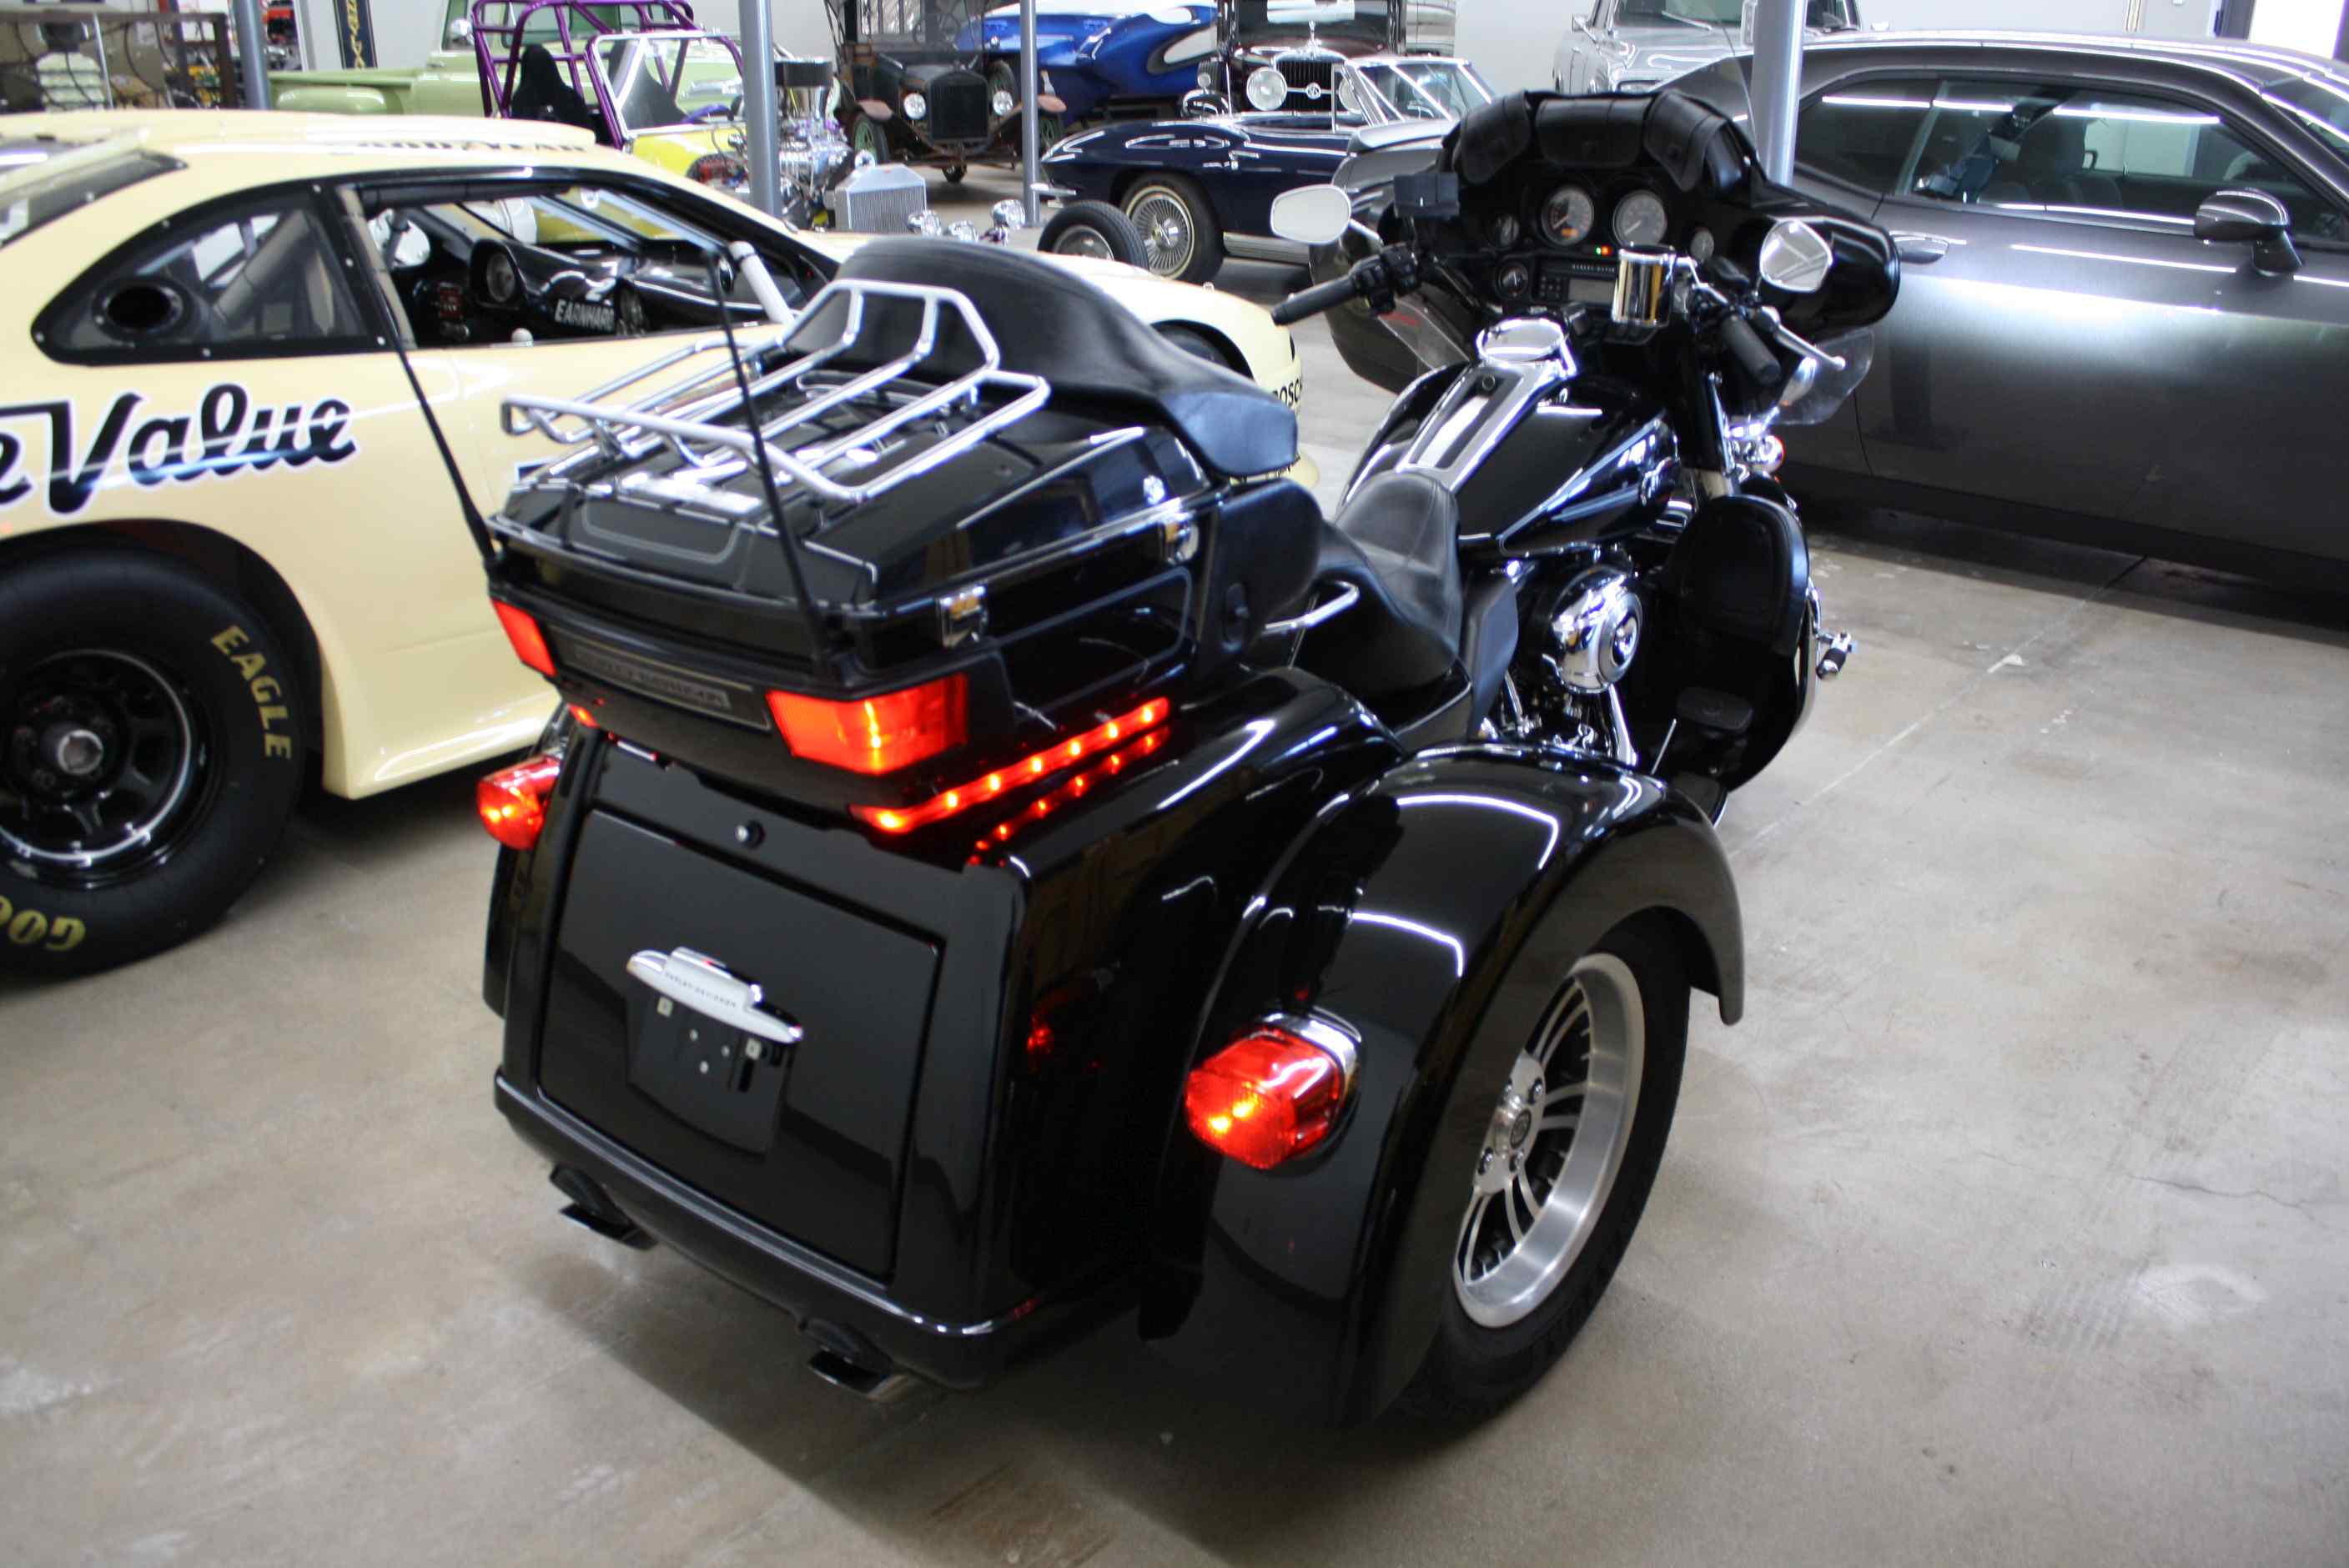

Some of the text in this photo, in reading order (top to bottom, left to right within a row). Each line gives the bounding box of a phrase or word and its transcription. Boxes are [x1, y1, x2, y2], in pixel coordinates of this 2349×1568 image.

[48, 384, 357, 514] Value
[1272, 375, 1302, 407] OSC
[211, 624, 292, 760] EAGLE
